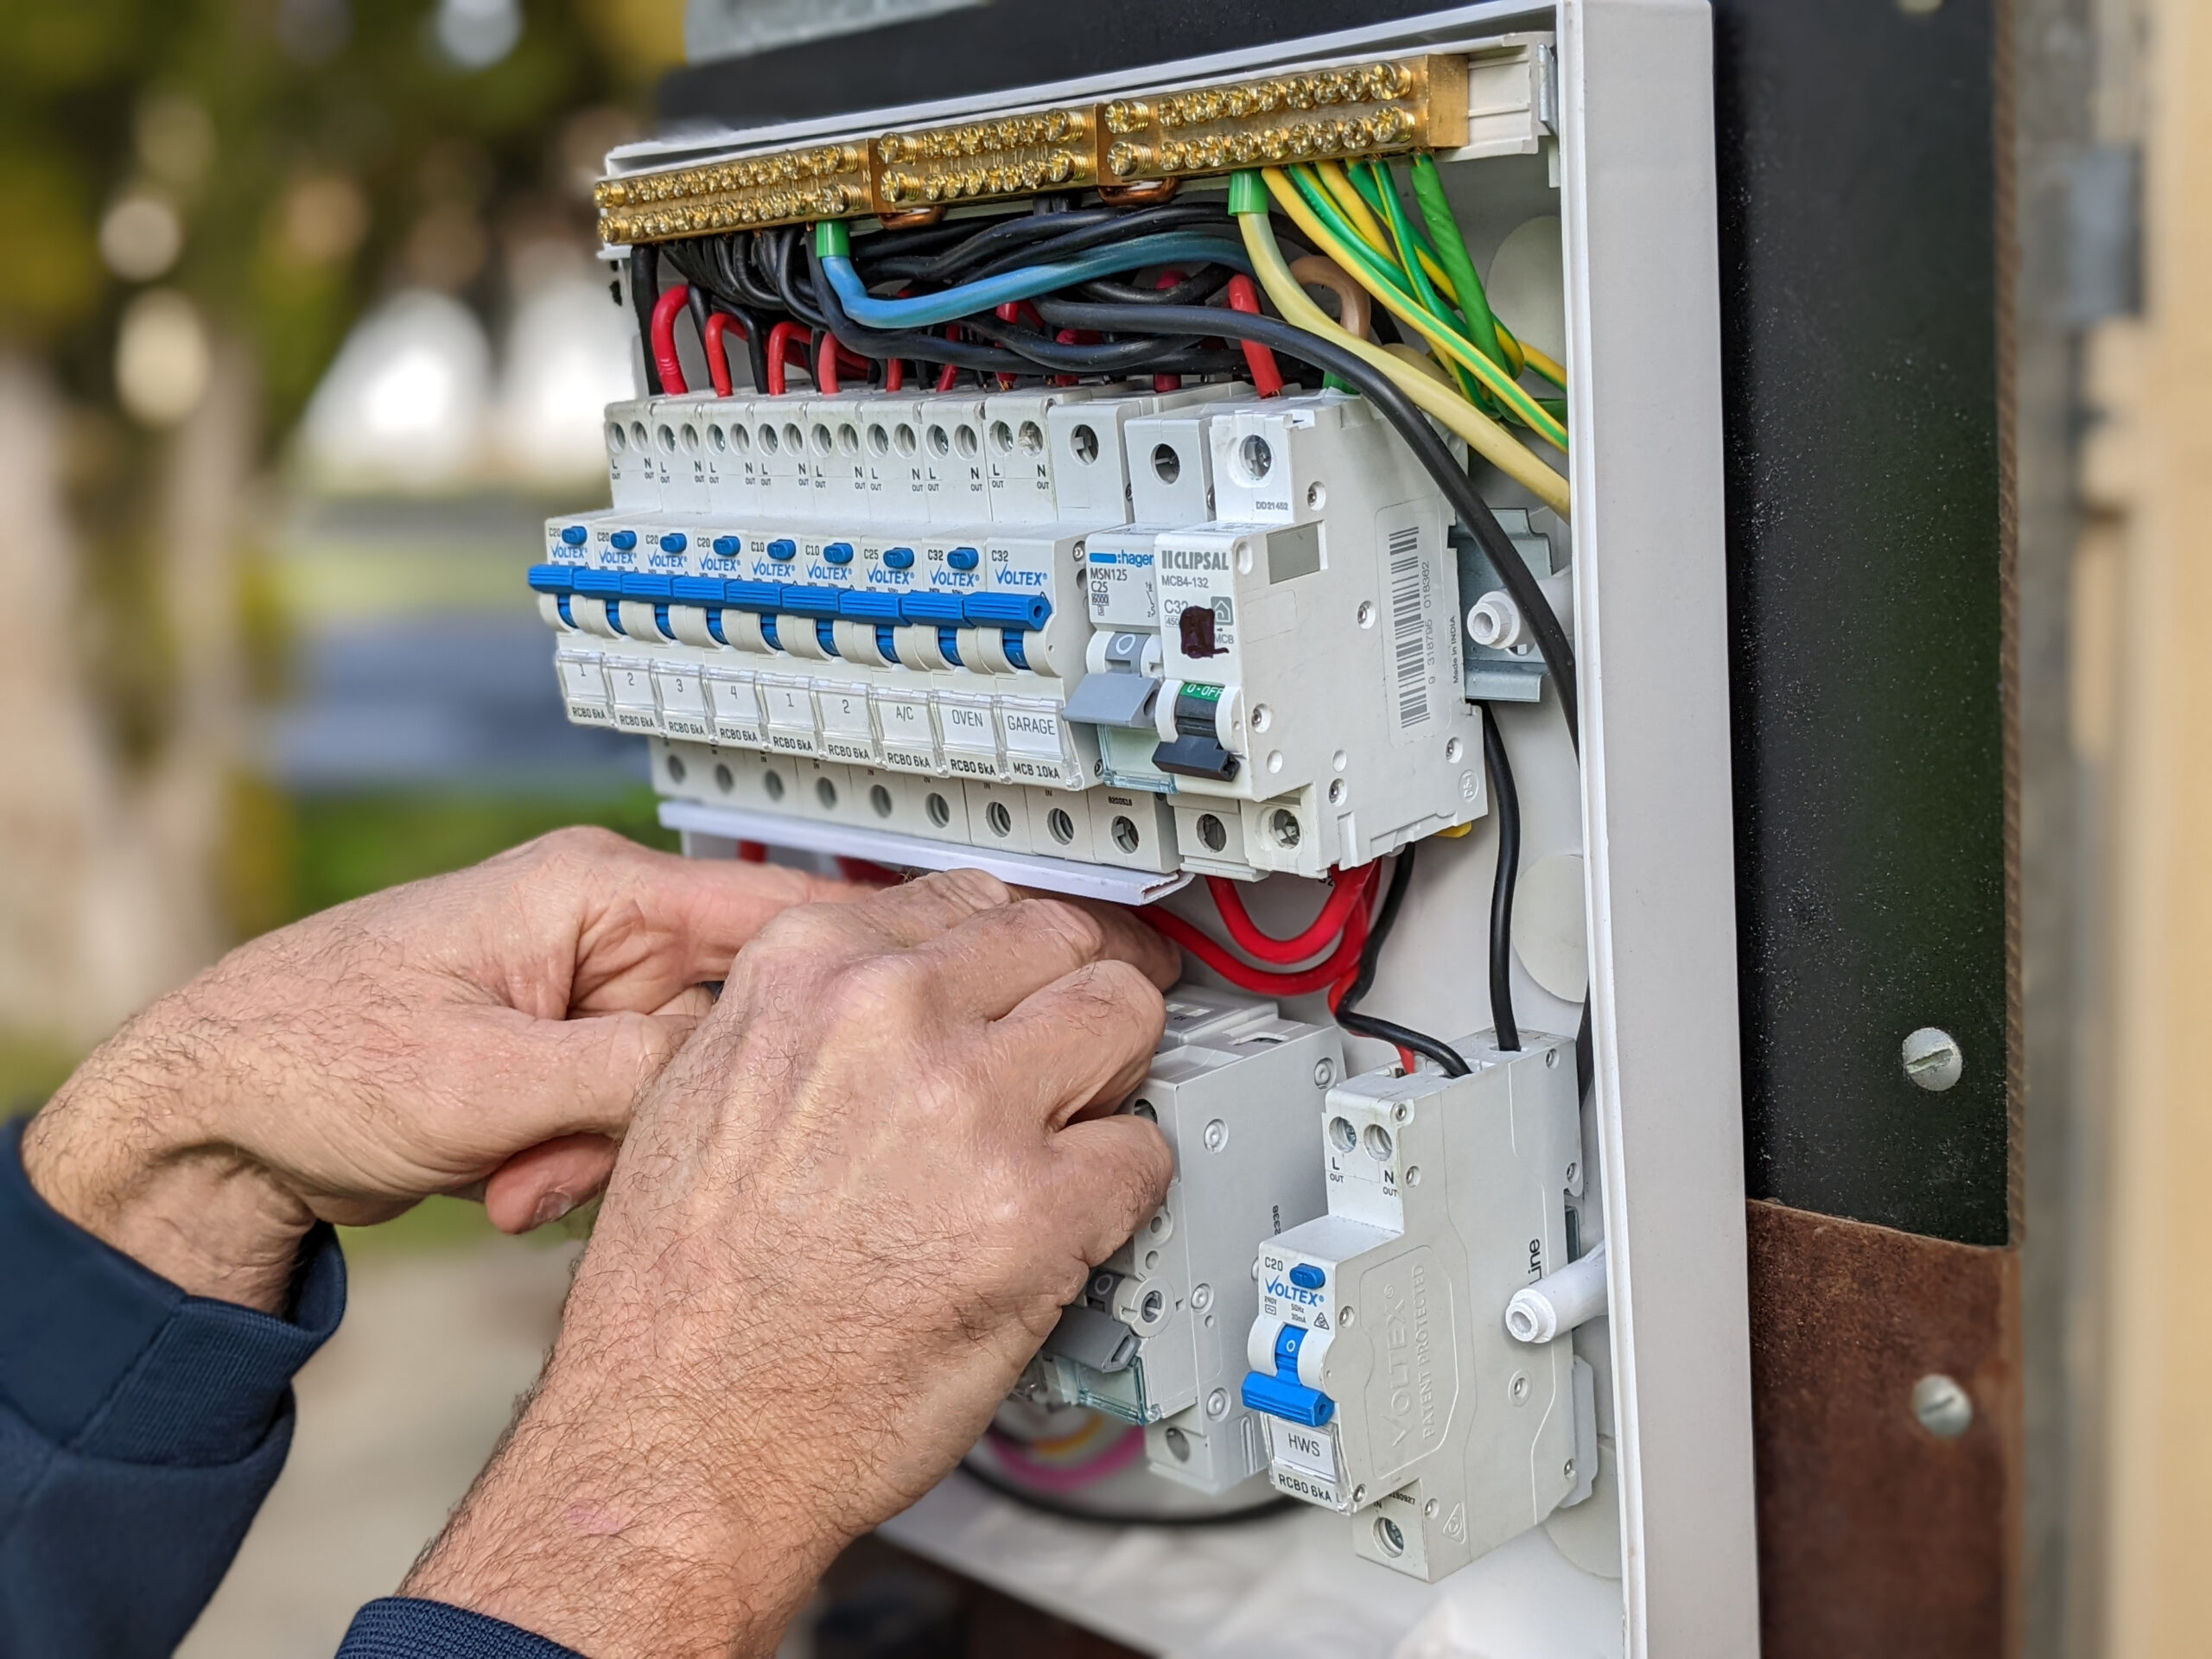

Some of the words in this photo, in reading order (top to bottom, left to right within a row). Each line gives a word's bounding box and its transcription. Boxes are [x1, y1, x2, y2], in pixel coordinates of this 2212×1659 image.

[612, 459, 618, 469] L
[645, 458, 652, 469] N
[660, 461, 666, 473] L
[695, 461, 702, 472] N
[710, 462, 716, 473] L
[745, 462, 753, 474] N
[761, 463, 768, 474] L
[798, 463, 806, 474] N
[993, 463, 1000, 476] L
[817, 465, 823, 477] L
[855, 466, 862, 478] N
[872, 467, 878, 480] L
[912, 468, 920, 480] N
[929, 467, 937, 479] L
[970, 467, 980, 480] N
[1037, 464, 1046, 477] N
[912, 484, 924, 493] OUT
[1037, 481, 1049, 490] OUT
[549, 528, 561, 537] C20
[597, 532, 610, 542] C20
[645, 535, 658, 544] C20
[697, 537, 710, 548] C20
[751, 542, 765, 553] C10
[805, 545, 820, 556] C10
[864, 550, 879, 560] C25
[927, 550, 944, 561] C32
[991, 550, 1008, 562] C32
[1090, 568, 1128, 581] MSN125
[1090, 581, 1109, 593] C25
[1161, 575, 1209, 588] MCB4-132
[1422, 561, 1431, 608] 018362
[1426, 619, 1435, 665] 318795
[1452, 648, 1458, 658] in
[579, 664, 586, 677] 1
[627, 672, 635, 686] 2
[676, 678, 683, 692] 3
[730, 685, 738, 699] 4
[785, 693, 794, 708] 1
[842, 699, 850, 714] 2
[572, 707, 590, 719] RCBO
[593, 709, 606, 720] 6kA
[896, 706, 914, 722] A/C
[952, 709, 983, 728] OVEN
[620, 715, 639, 727] RCBO
[640, 716, 655, 728] 6kA
[669, 721, 689, 734] RCBO
[690, 723, 706, 735] 6kA
[1007, 715, 1056, 735] GARAGE
[720, 728, 741, 741] RCBO
[742, 730, 758, 742] 6kA
[773, 736, 795, 749] RCBO
[797, 739, 813, 752] 6kA
[828, 745, 851, 758] RCBO
[853, 747, 870, 760] 6kA
[887, 753, 912, 766] RCBO
[913, 755, 931, 768] 6kA
[950, 759, 976, 772] RCBO
[978, 761, 996, 776] 6kA
[1013, 762, 1033, 776] MCB
[1037, 766, 1061, 779] 10kA
[1332, 1157, 1339, 1170] L
[1330, 1173, 1344, 1183] OUT
[1384, 1170, 1394, 1184] N
[1382, 1186, 1398, 1197] OUT
[1265, 1257, 1283, 1272] C20
[1291, 1303, 1305, 1313] 50Hz
[1291, 1313, 1306, 1324] 30mA
[1412, 1264, 1430, 1366] PROTECTED
[1418, 1373, 1435, 1440] PATENT
[1288, 1433, 1320, 1458] HWS
[1279, 1473, 1308, 1494] RCBO
[1311, 1484, 1332, 1503] 6kA
